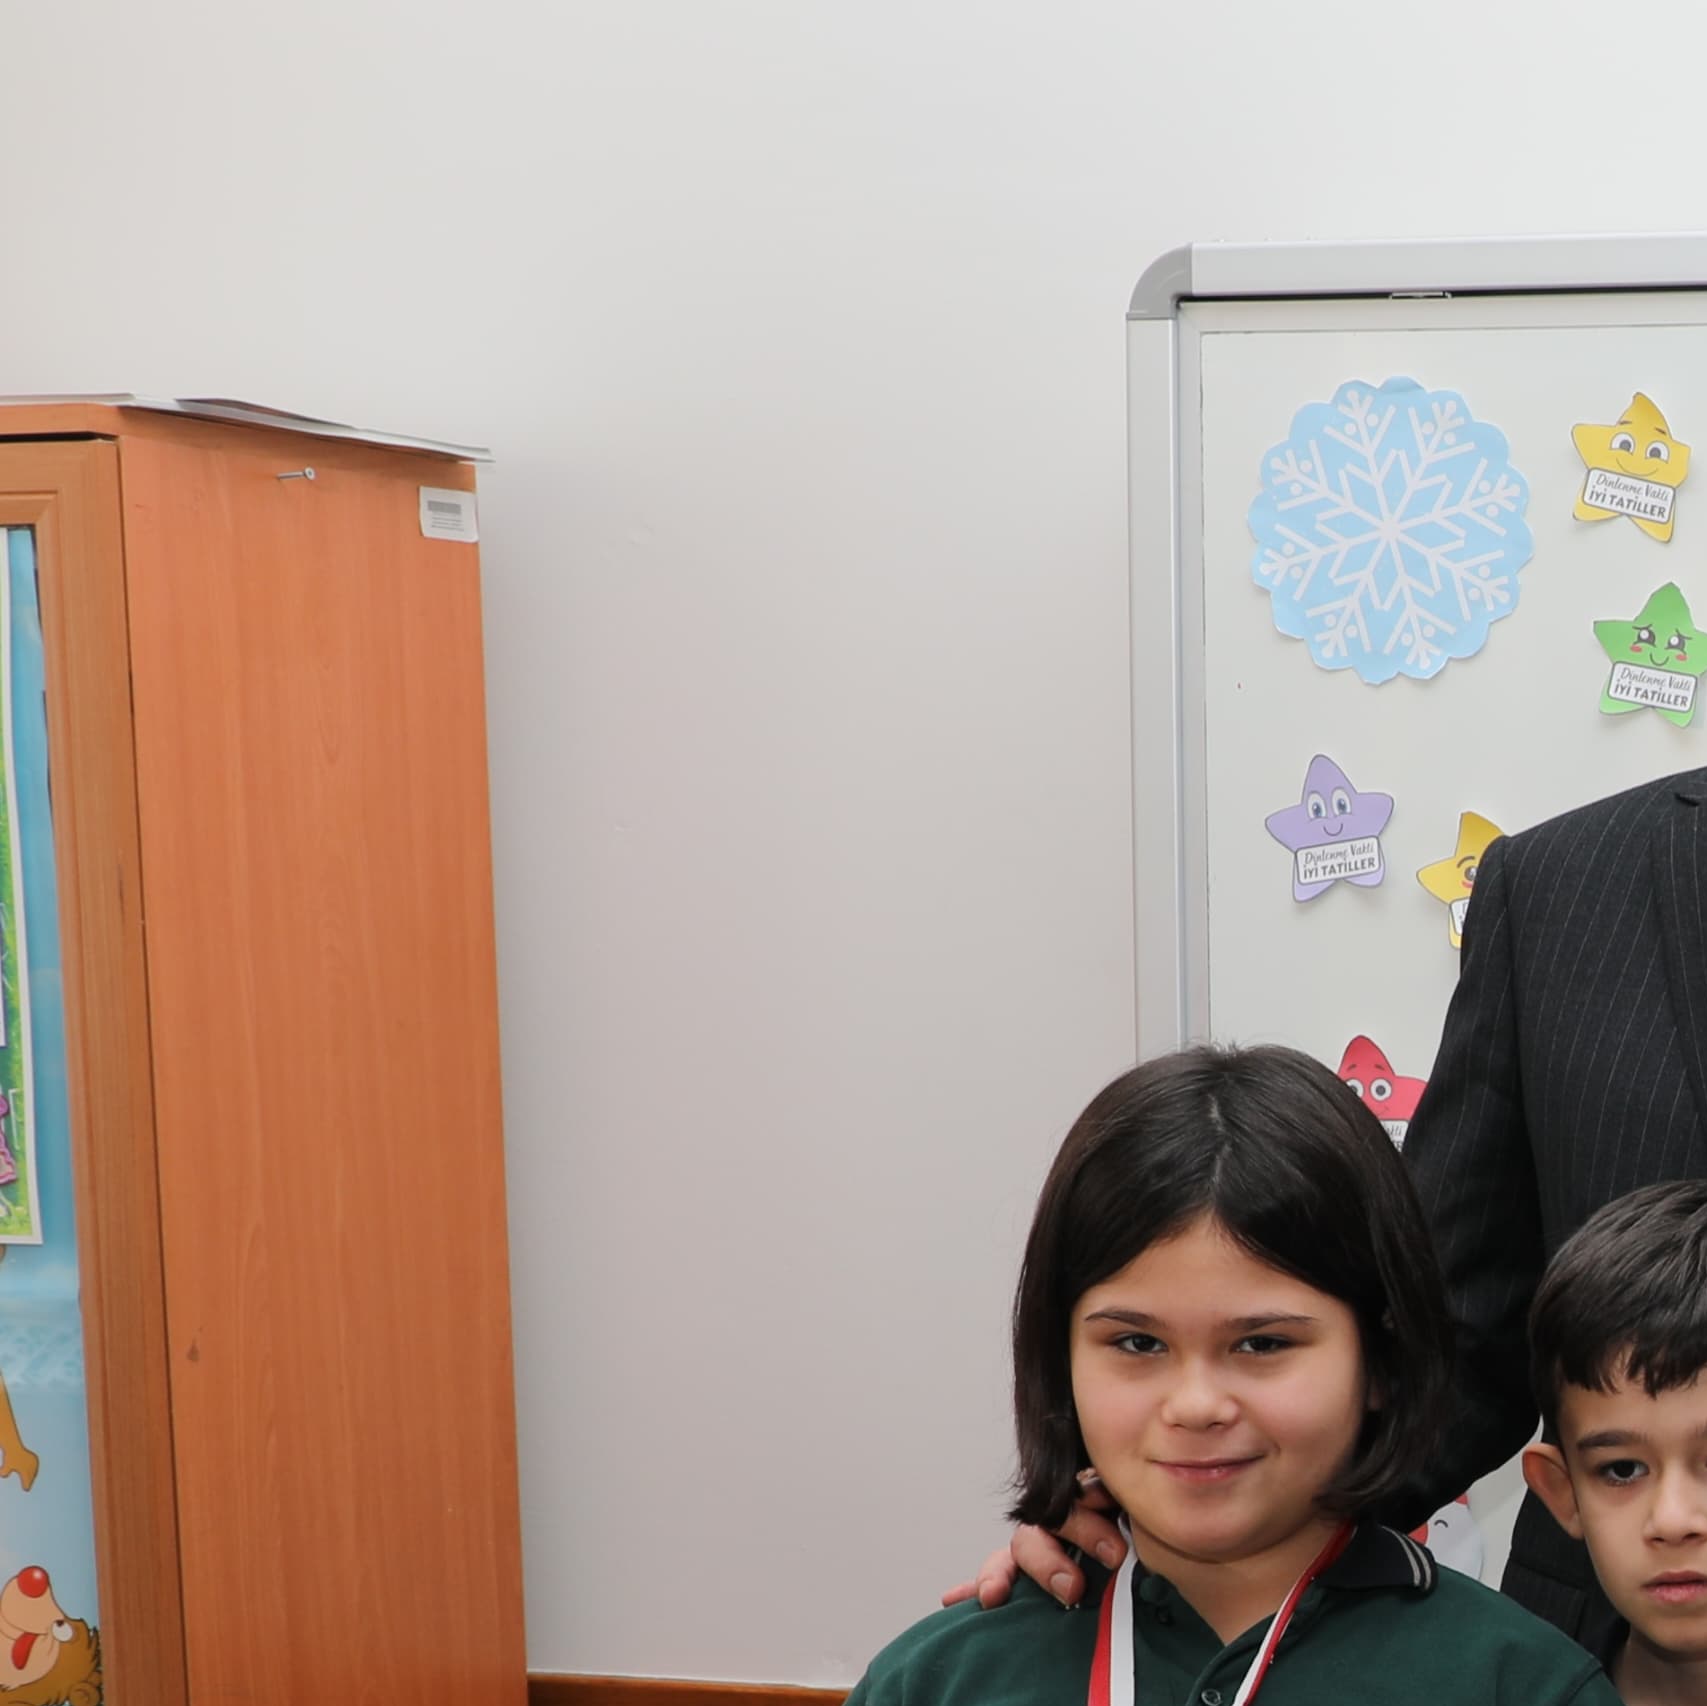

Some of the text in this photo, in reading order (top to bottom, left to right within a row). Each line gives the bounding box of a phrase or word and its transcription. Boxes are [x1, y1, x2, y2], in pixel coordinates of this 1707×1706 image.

[1610, 494, 1666, 518] TATİLLER
[1635, 686, 1688, 707] TATİLLER
[1321, 857, 1376, 876] TATİLLER
